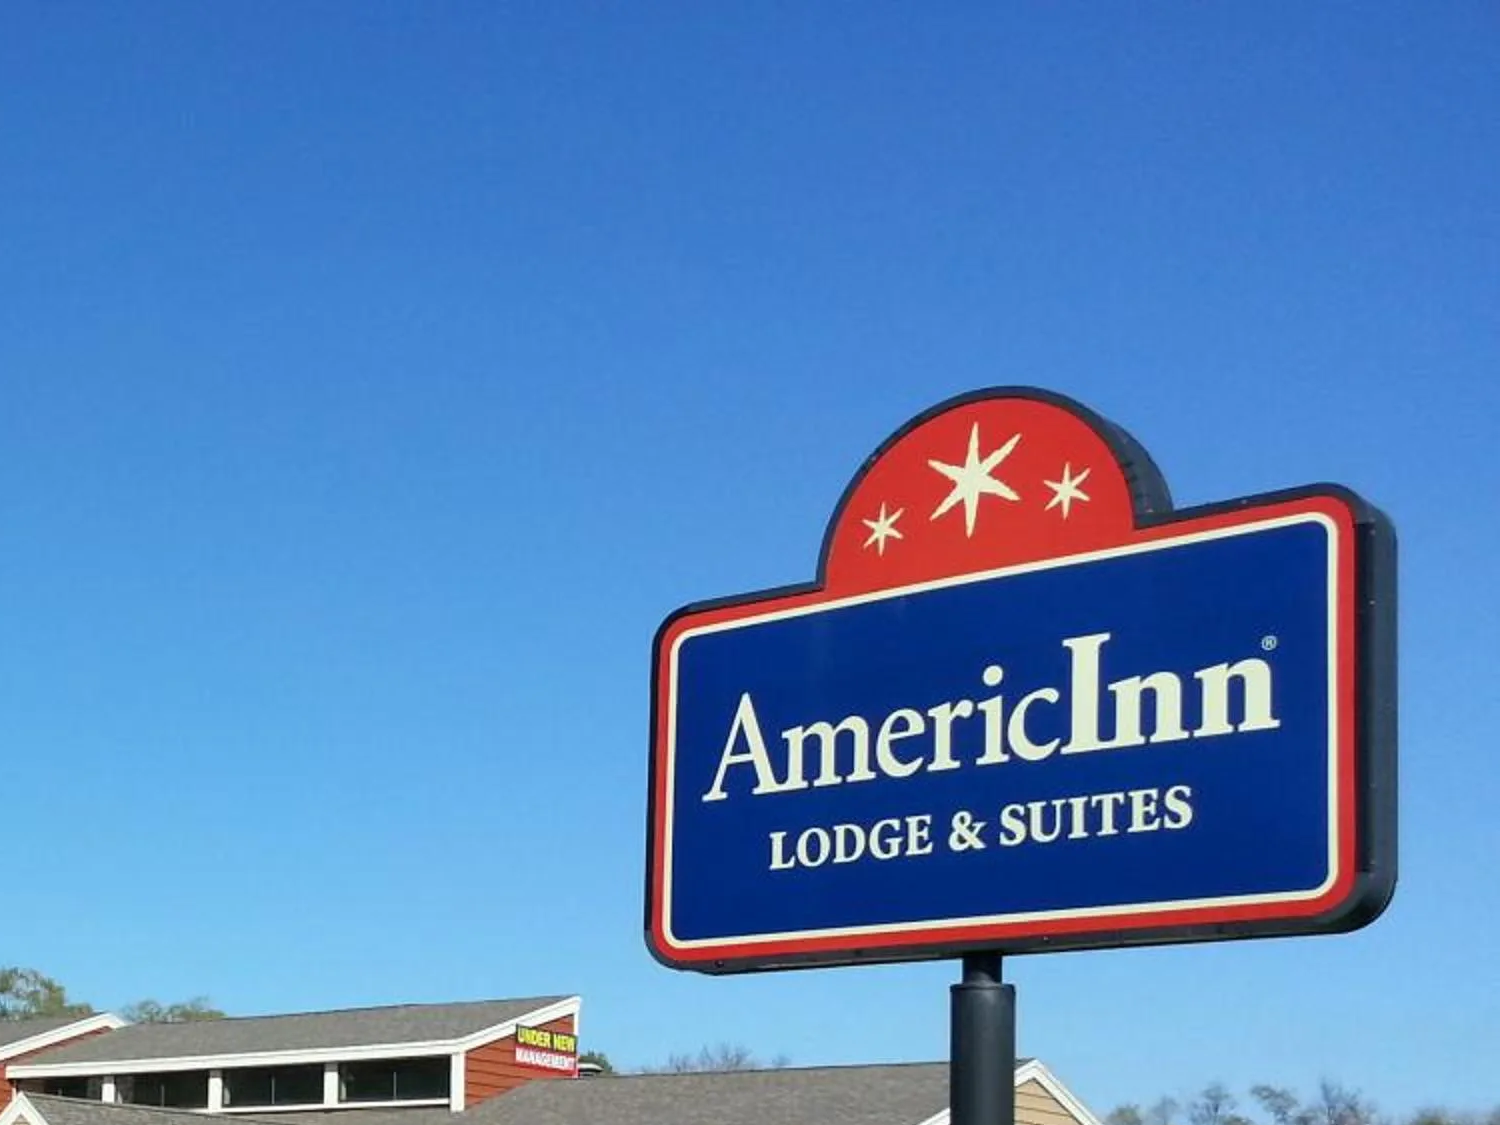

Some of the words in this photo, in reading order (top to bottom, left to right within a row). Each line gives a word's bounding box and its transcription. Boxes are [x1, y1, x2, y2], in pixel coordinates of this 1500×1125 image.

[702, 632, 1280, 802] AmericInn
[769, 813, 933, 870] LODGE
[948, 811, 986, 851] &
[999, 785, 1193, 846] SUITES
[517, 1027, 552, 1049] UNDER
[553, 1033, 576, 1053] NEW
